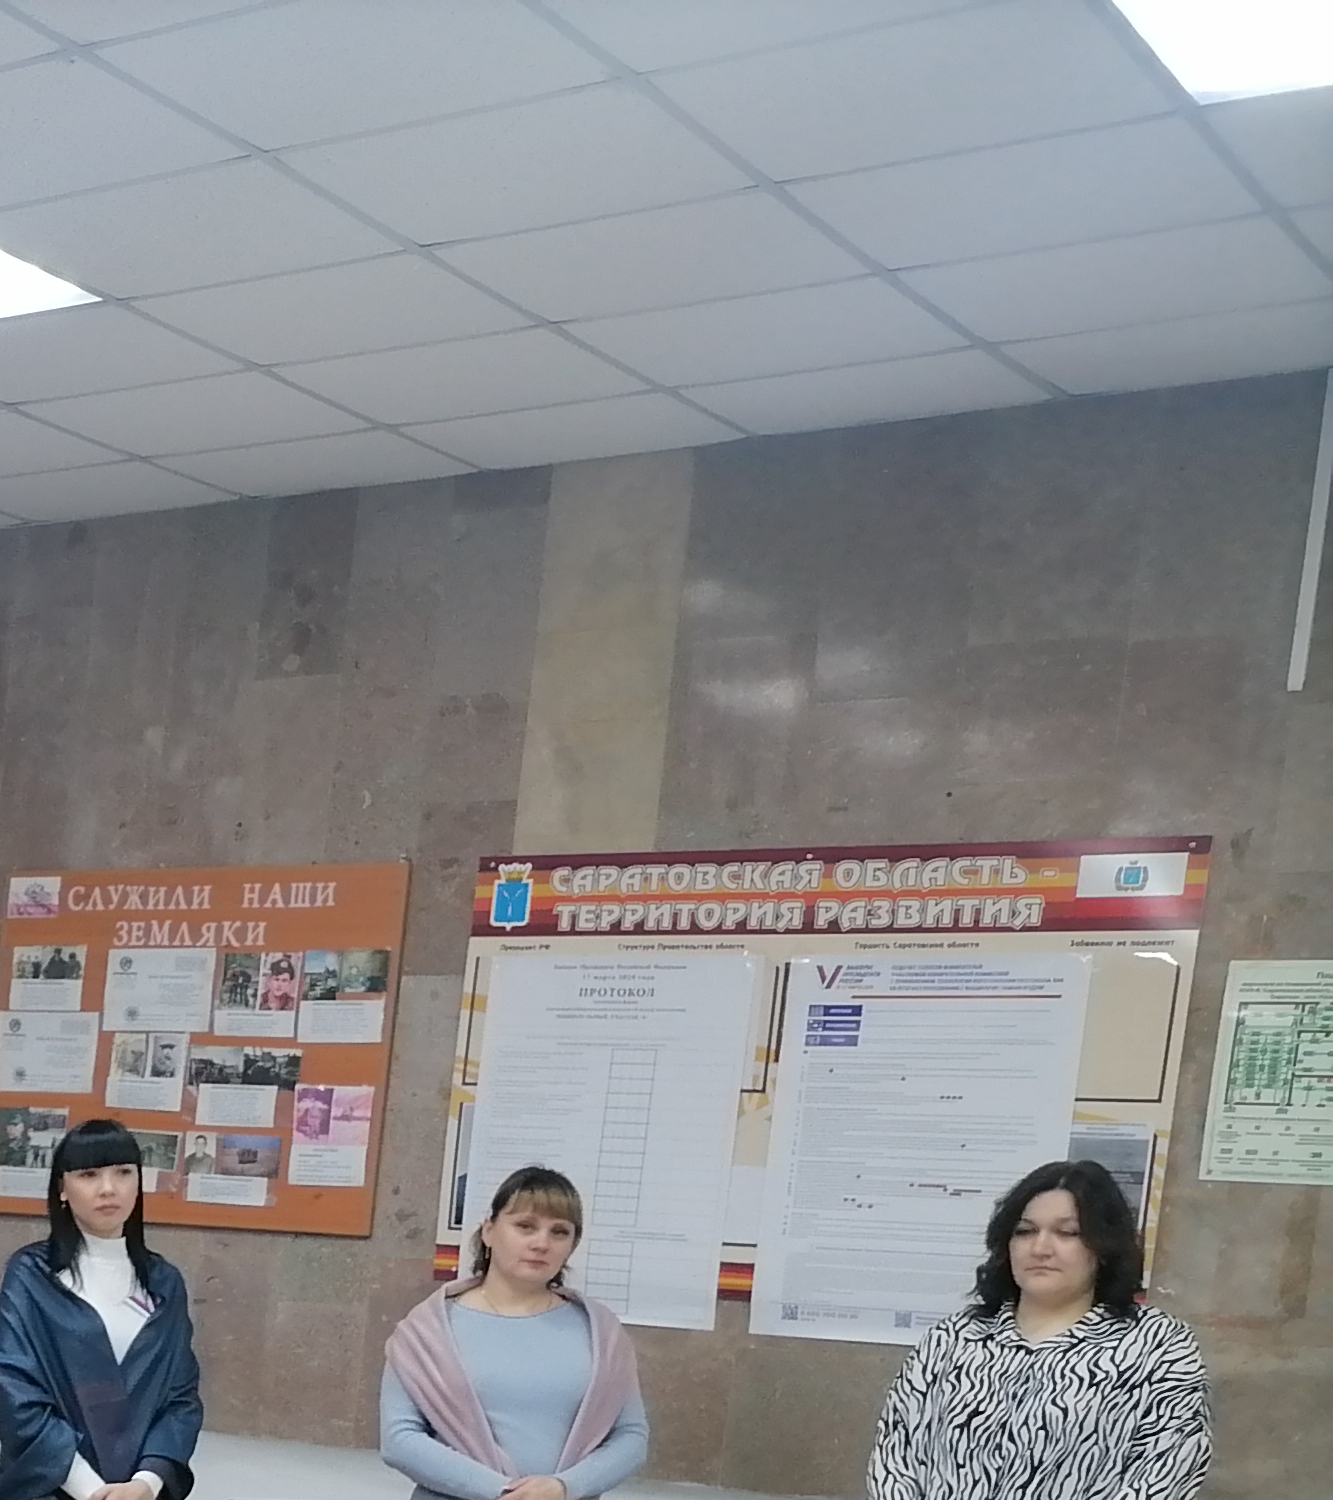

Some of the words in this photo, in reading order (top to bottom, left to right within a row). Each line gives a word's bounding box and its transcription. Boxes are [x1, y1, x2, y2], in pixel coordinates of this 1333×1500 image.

[549, 859, 823, 897] САРАТОВСКАЯ
[834, 855, 1030, 890] ОБЛАСТЬ
[67, 885, 211, 911] СЛУЖИЛИ
[241, 882, 337, 909] НАШИ
[552, 899, 803, 933] ТЕРРИТОРИЯ
[812, 895, 1045, 930] РАЗВИТИЯ
[112, 919, 267, 947] ЗЕМЛЯКИ
[947, 940, 980, 948] области
[578, 987, 655, 998] ПРОТОКОЛ
